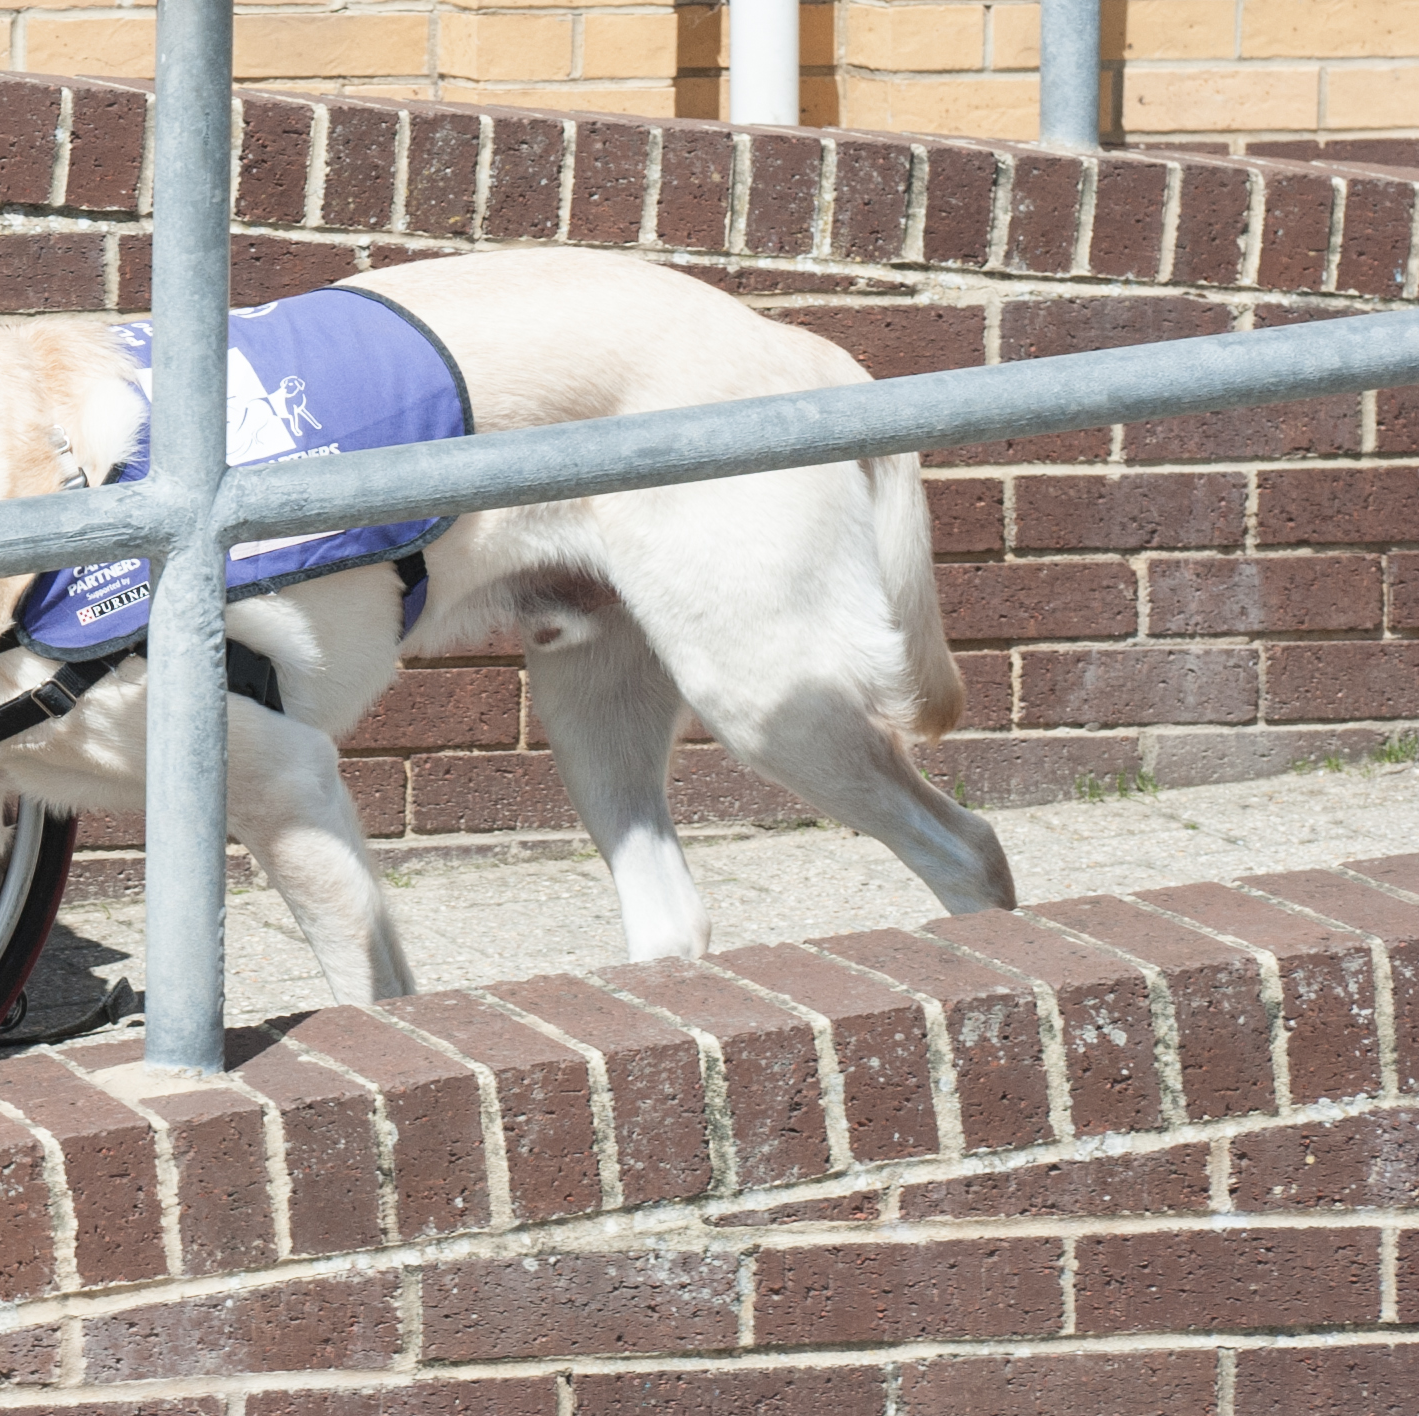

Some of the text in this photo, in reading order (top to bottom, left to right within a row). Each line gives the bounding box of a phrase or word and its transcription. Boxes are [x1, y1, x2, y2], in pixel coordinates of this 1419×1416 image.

[67, 558, 141, 597] PARTNERS
[86, 577, 131, 601] Supported by
[92, 586, 150, 617] PURINA
